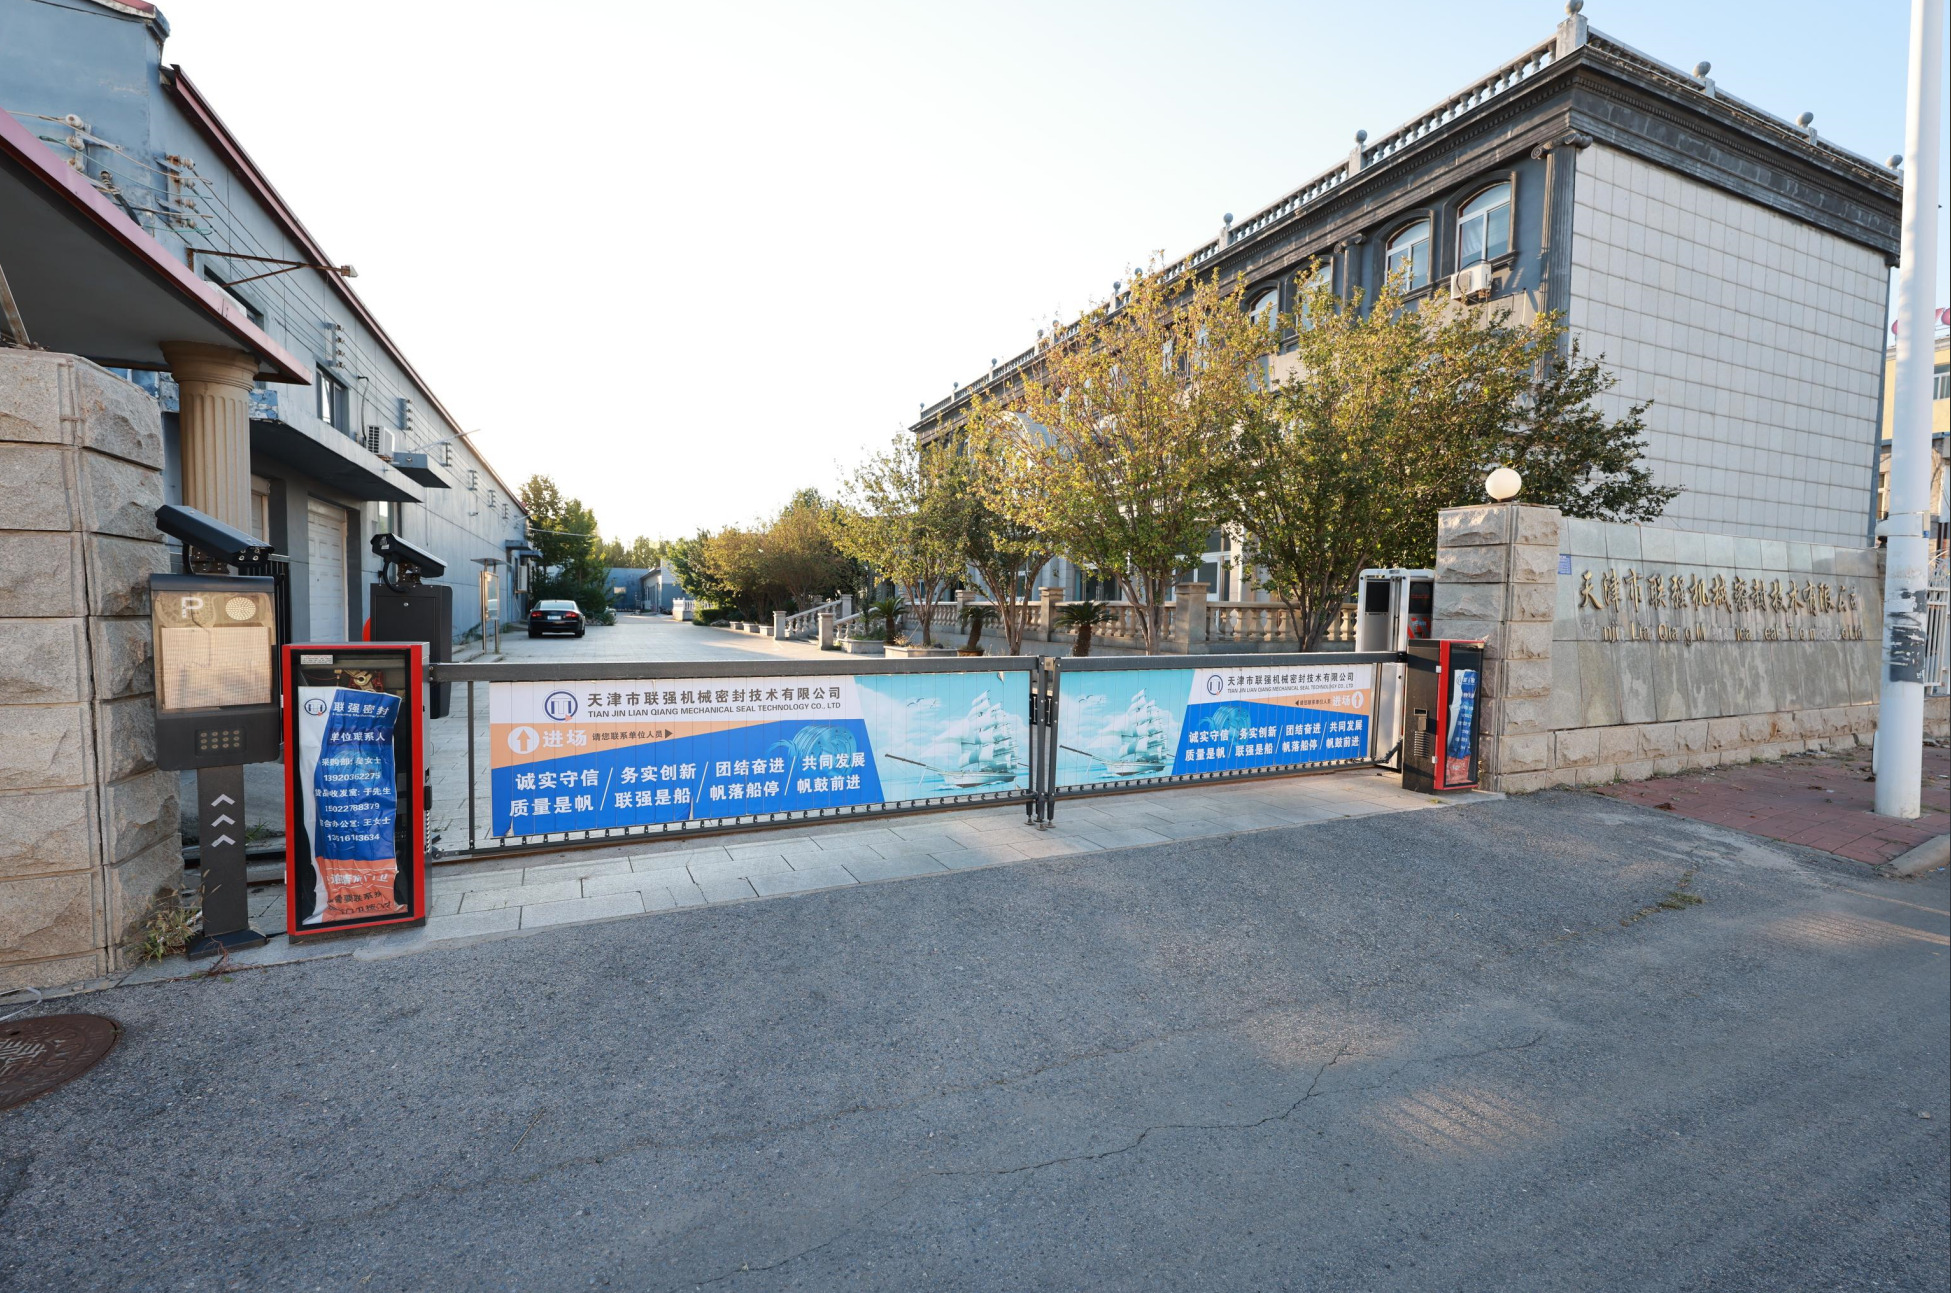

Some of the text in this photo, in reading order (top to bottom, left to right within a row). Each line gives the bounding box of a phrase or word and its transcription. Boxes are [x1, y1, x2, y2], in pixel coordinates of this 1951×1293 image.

[181, 596, 204, 619] P
[1228, 672, 1354, 686] 天津市联强机械密封技术有限公司
[587, 686, 841, 707] 天津市联强机械密封技术有限公司
[333, 701, 390, 716] 联强密封
[588, 710, 609, 718] TIAN
[650, 708, 678, 716] QIANG
[680, 706, 734, 714] MECHANICAL
[736, 705, 756, 713] SEAL
[758, 703, 809, 712] TECHNOLOGY
[330, 731, 386, 742] 单位联系人
[542, 729, 663, 748] 进场 请您联系单位人员
[1188, 719, 1363, 743] 诚实守信 务实创新 团结奋进 共同发展
[1185, 735, 1359, 762] 质量是帆 联强是船 帆落船停 帆鼓前进
[515, 752, 865, 791] 诚实守信 务实创新 团结奋进 共同发展
[509, 774, 861, 818] 质量是帆 联强是船 帆落船停 帆鼓前进
